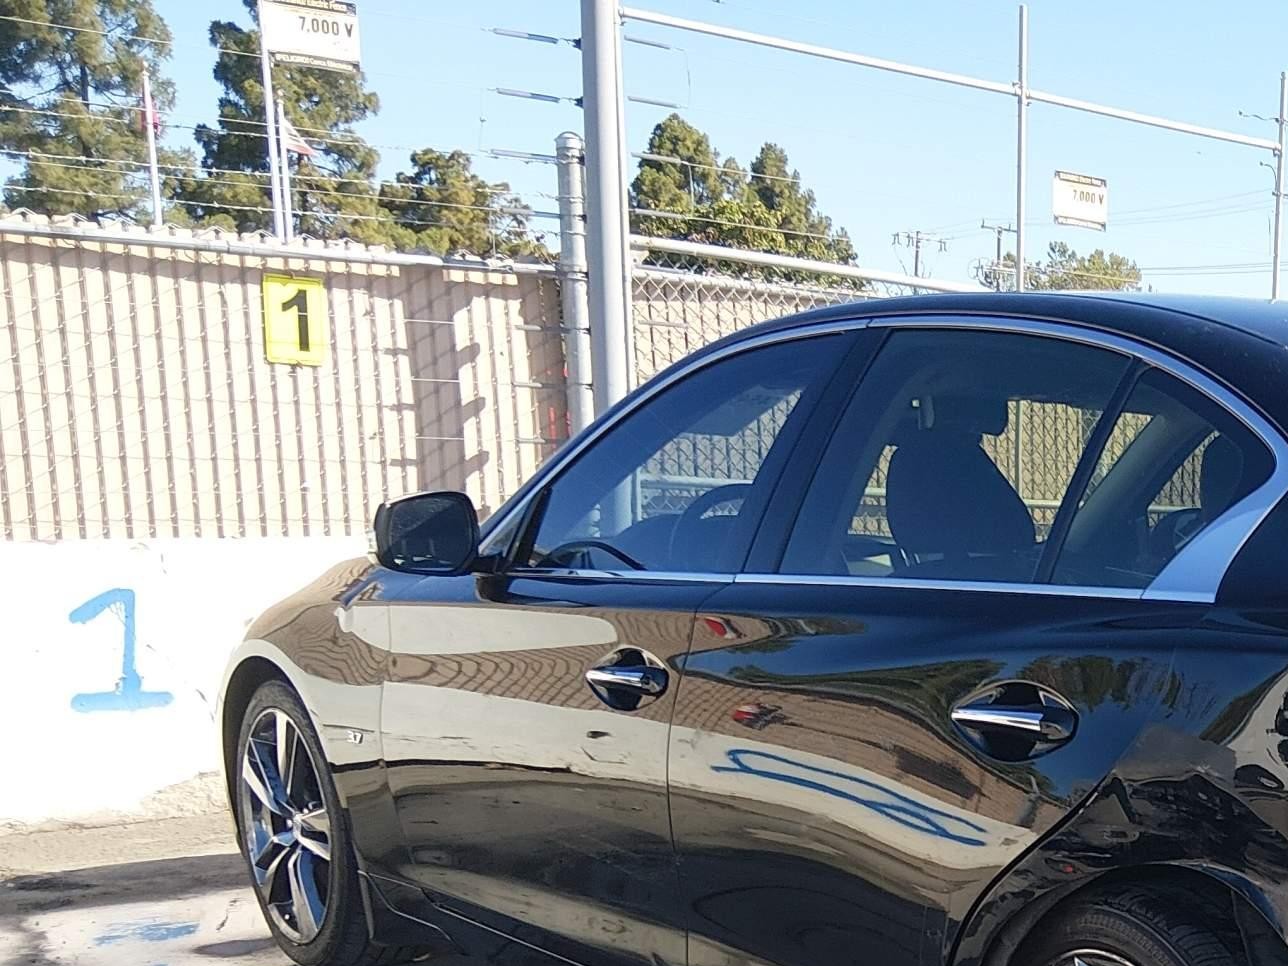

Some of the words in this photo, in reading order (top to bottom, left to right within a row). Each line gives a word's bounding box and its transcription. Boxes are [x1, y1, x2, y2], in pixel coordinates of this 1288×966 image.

[344, 23, 353, 38] V
[1098, 193, 1104, 205] V
[281, 288, 310, 352] 1
[69, 587, 174, 712] 1
